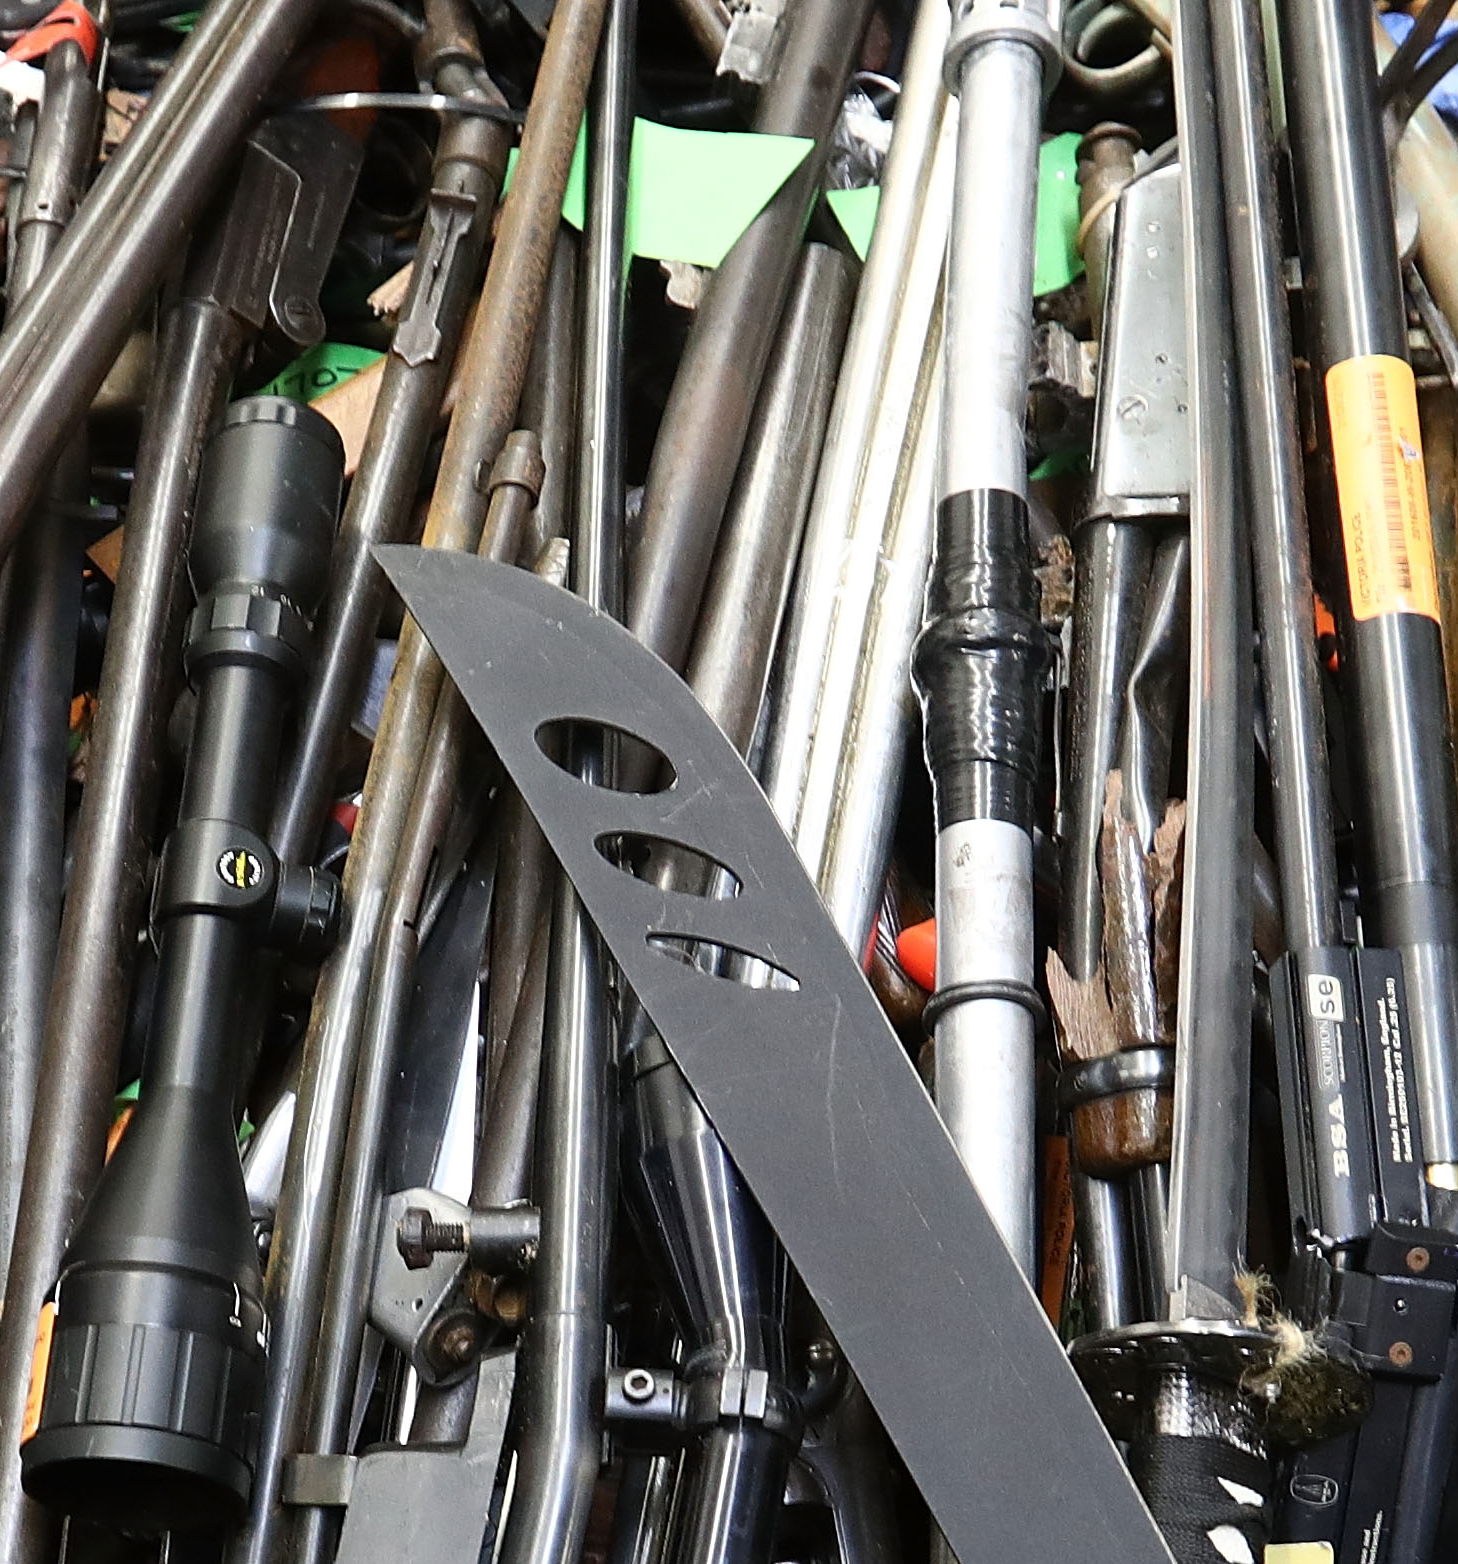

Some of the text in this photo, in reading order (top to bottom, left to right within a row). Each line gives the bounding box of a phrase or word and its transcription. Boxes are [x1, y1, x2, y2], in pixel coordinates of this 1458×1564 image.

[1352, 512, 1365, 552] POLICE
[1318, 980, 1335, 1014] se
[1377, 998, 1390, 1045] England.
[1319, 1020, 1336, 1085] SCORPION
[1383, 1046, 1397, 1117] Birmingham,
[1328, 1094, 1350, 1177] BSA
[1391, 1130, 1402, 1163] Made
